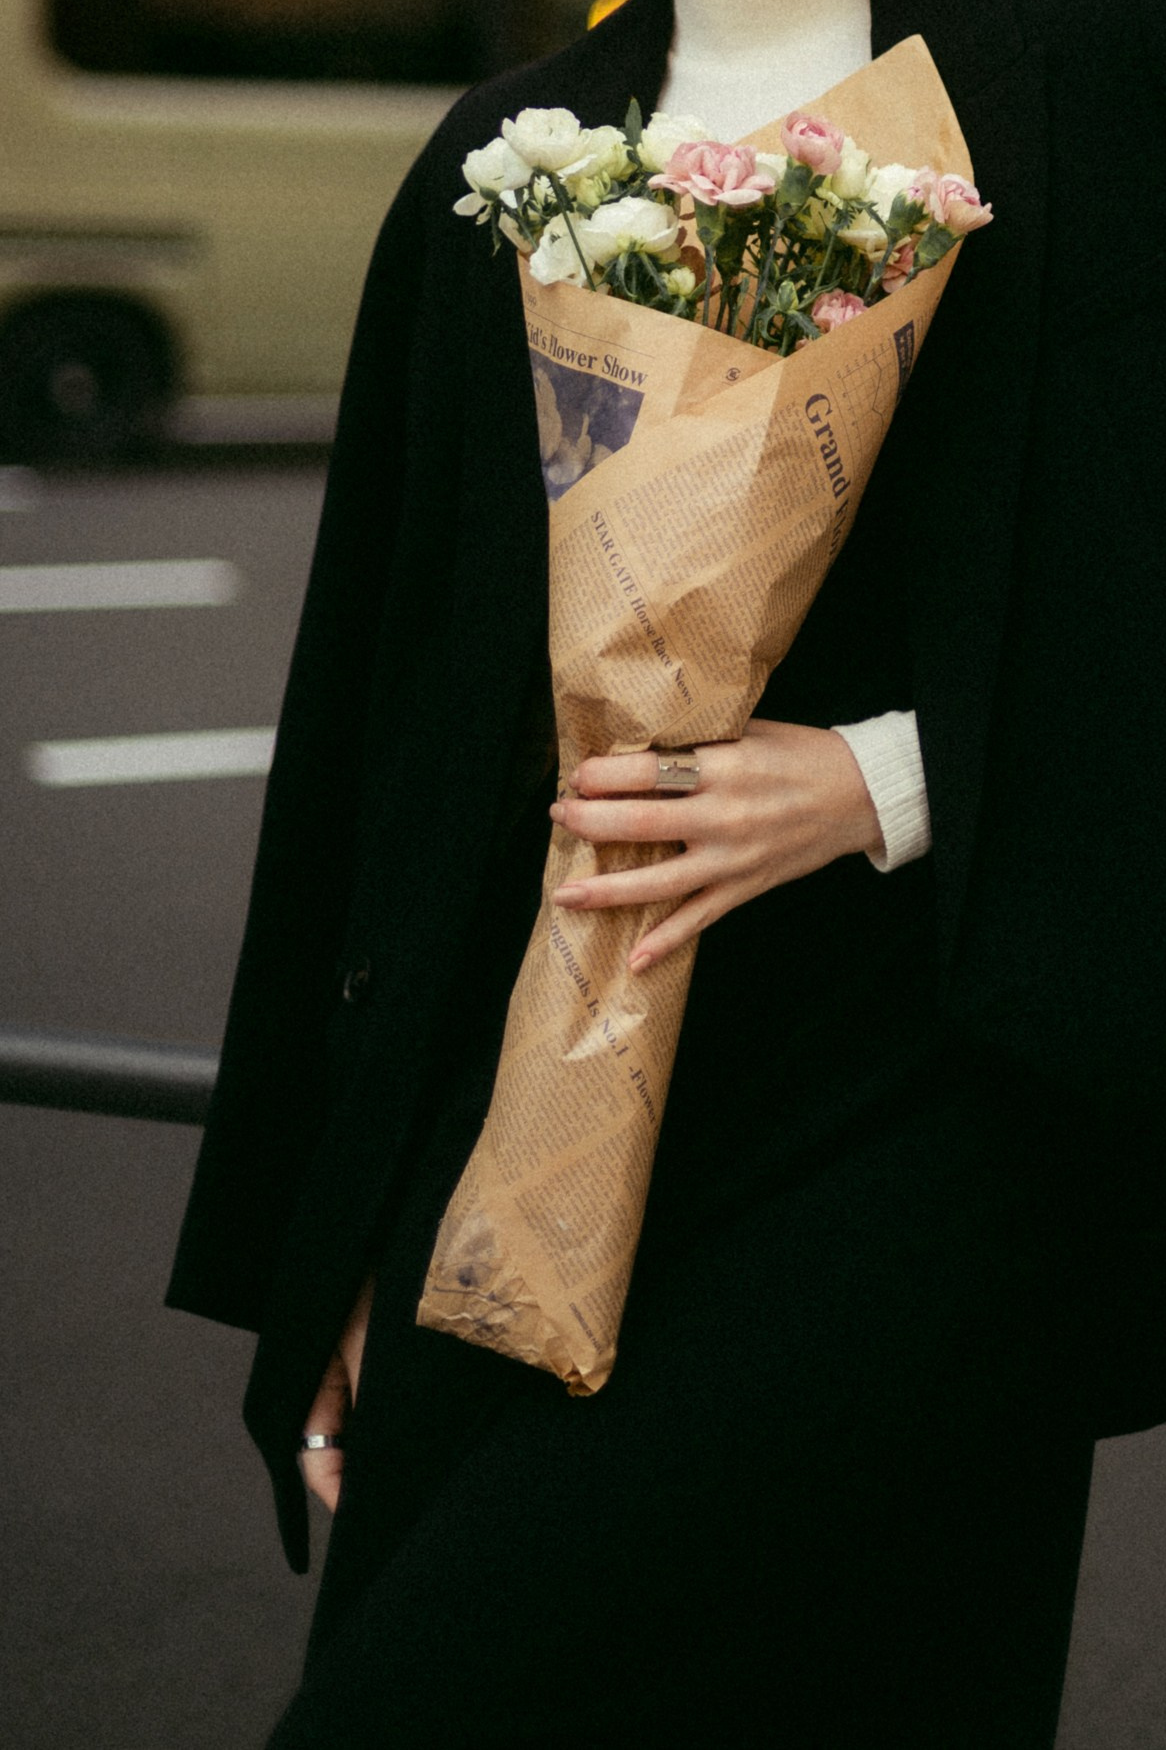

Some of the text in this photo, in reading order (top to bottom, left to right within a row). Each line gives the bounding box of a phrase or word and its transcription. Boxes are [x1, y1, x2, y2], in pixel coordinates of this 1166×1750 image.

[548, 335, 597, 369] Flower
[602, 354, 648, 386] Show
[805, 394, 850, 499] Grand
[591, 511, 695, 706] STAR GATE Horse Race News
[586, 999, 601, 1019] Is
[599, 1017, 629, 1058] No.1
